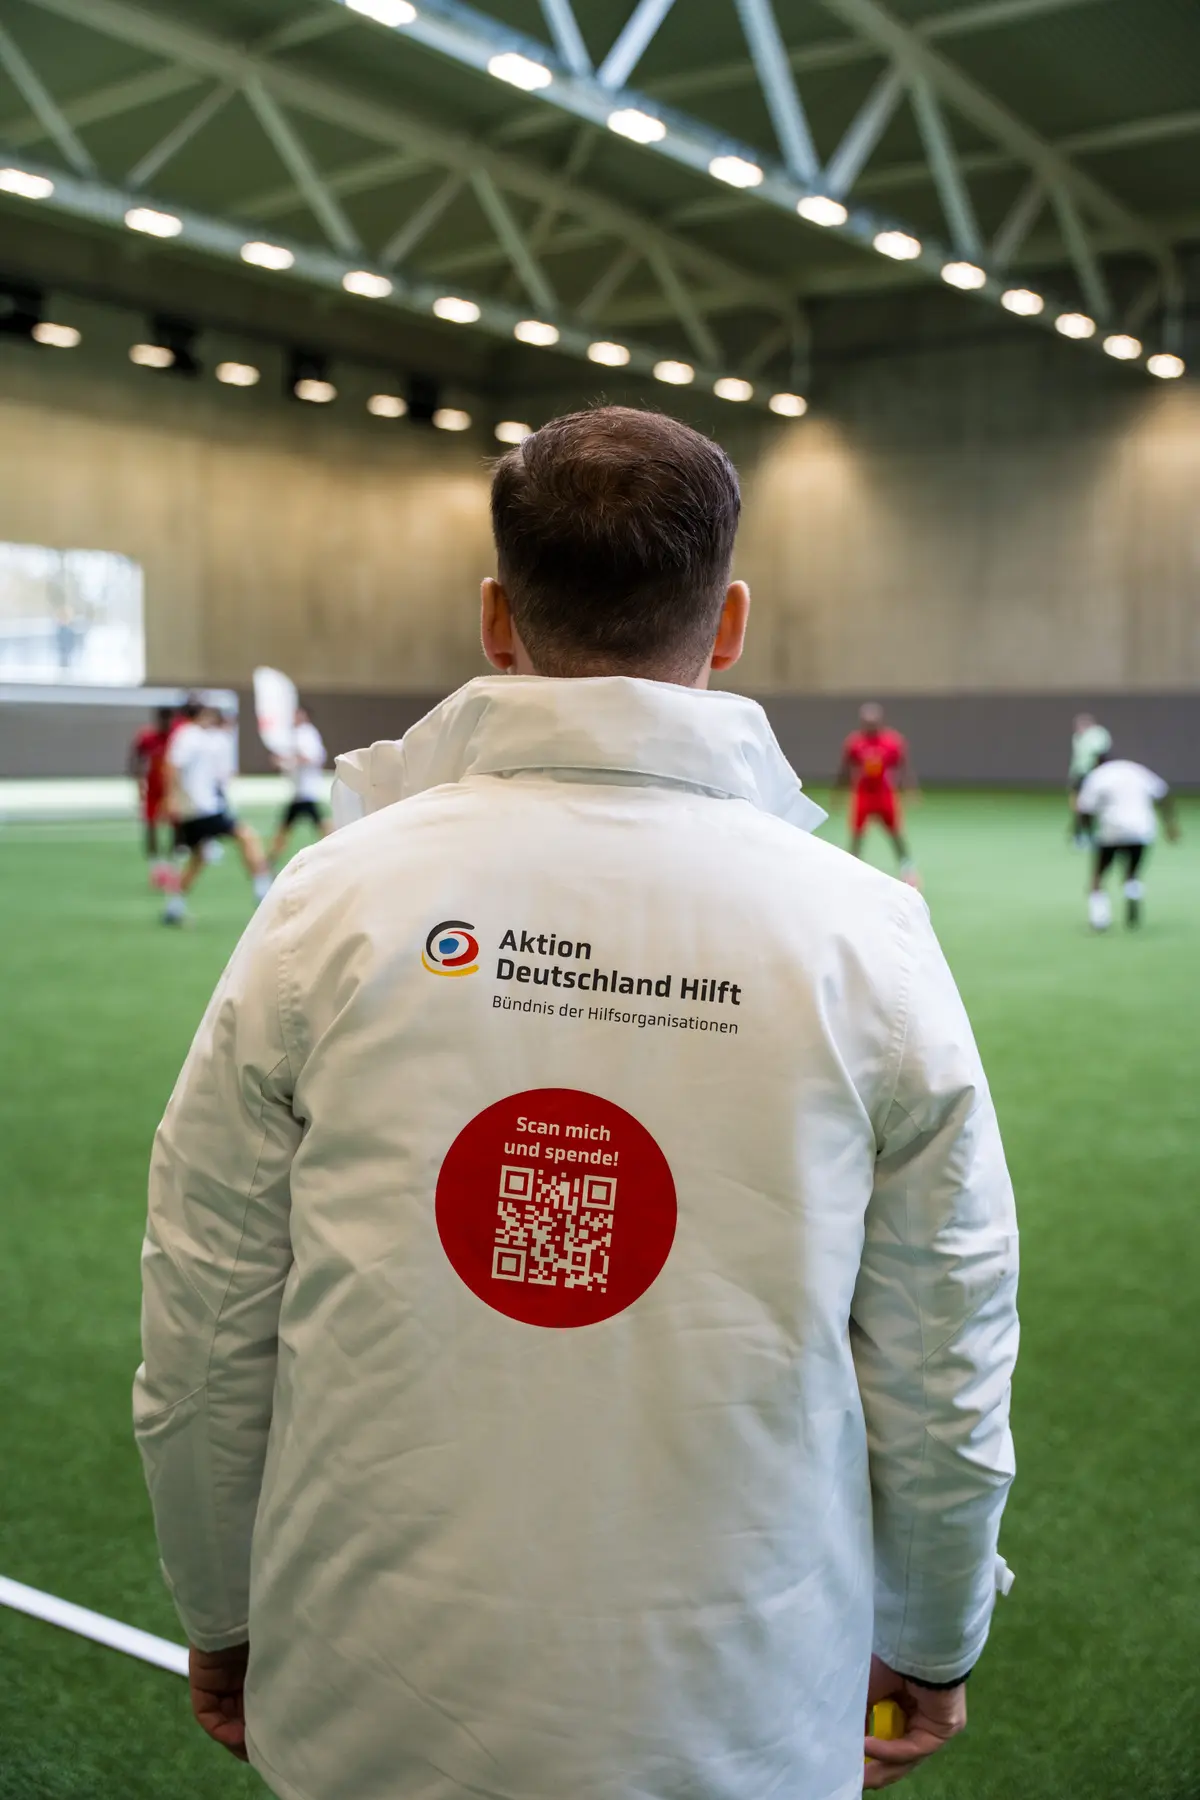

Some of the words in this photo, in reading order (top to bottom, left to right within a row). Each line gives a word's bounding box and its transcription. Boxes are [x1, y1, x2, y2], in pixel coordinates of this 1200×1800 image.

[498, 929, 592, 960] Aktion
[496, 958, 671, 998] Deutschland
[680, 977, 742, 1006] Hilft
[492, 995, 555, 1016] Bündnis
[559, 1002, 584, 1020] der
[588, 1007, 739, 1035] Hilfsorganisationen
[516, 1116, 560, 1136] Scan
[565, 1123, 611, 1142] mich
[504, 1141, 540, 1158] und
[545, 1147, 619, 1167] spende!
